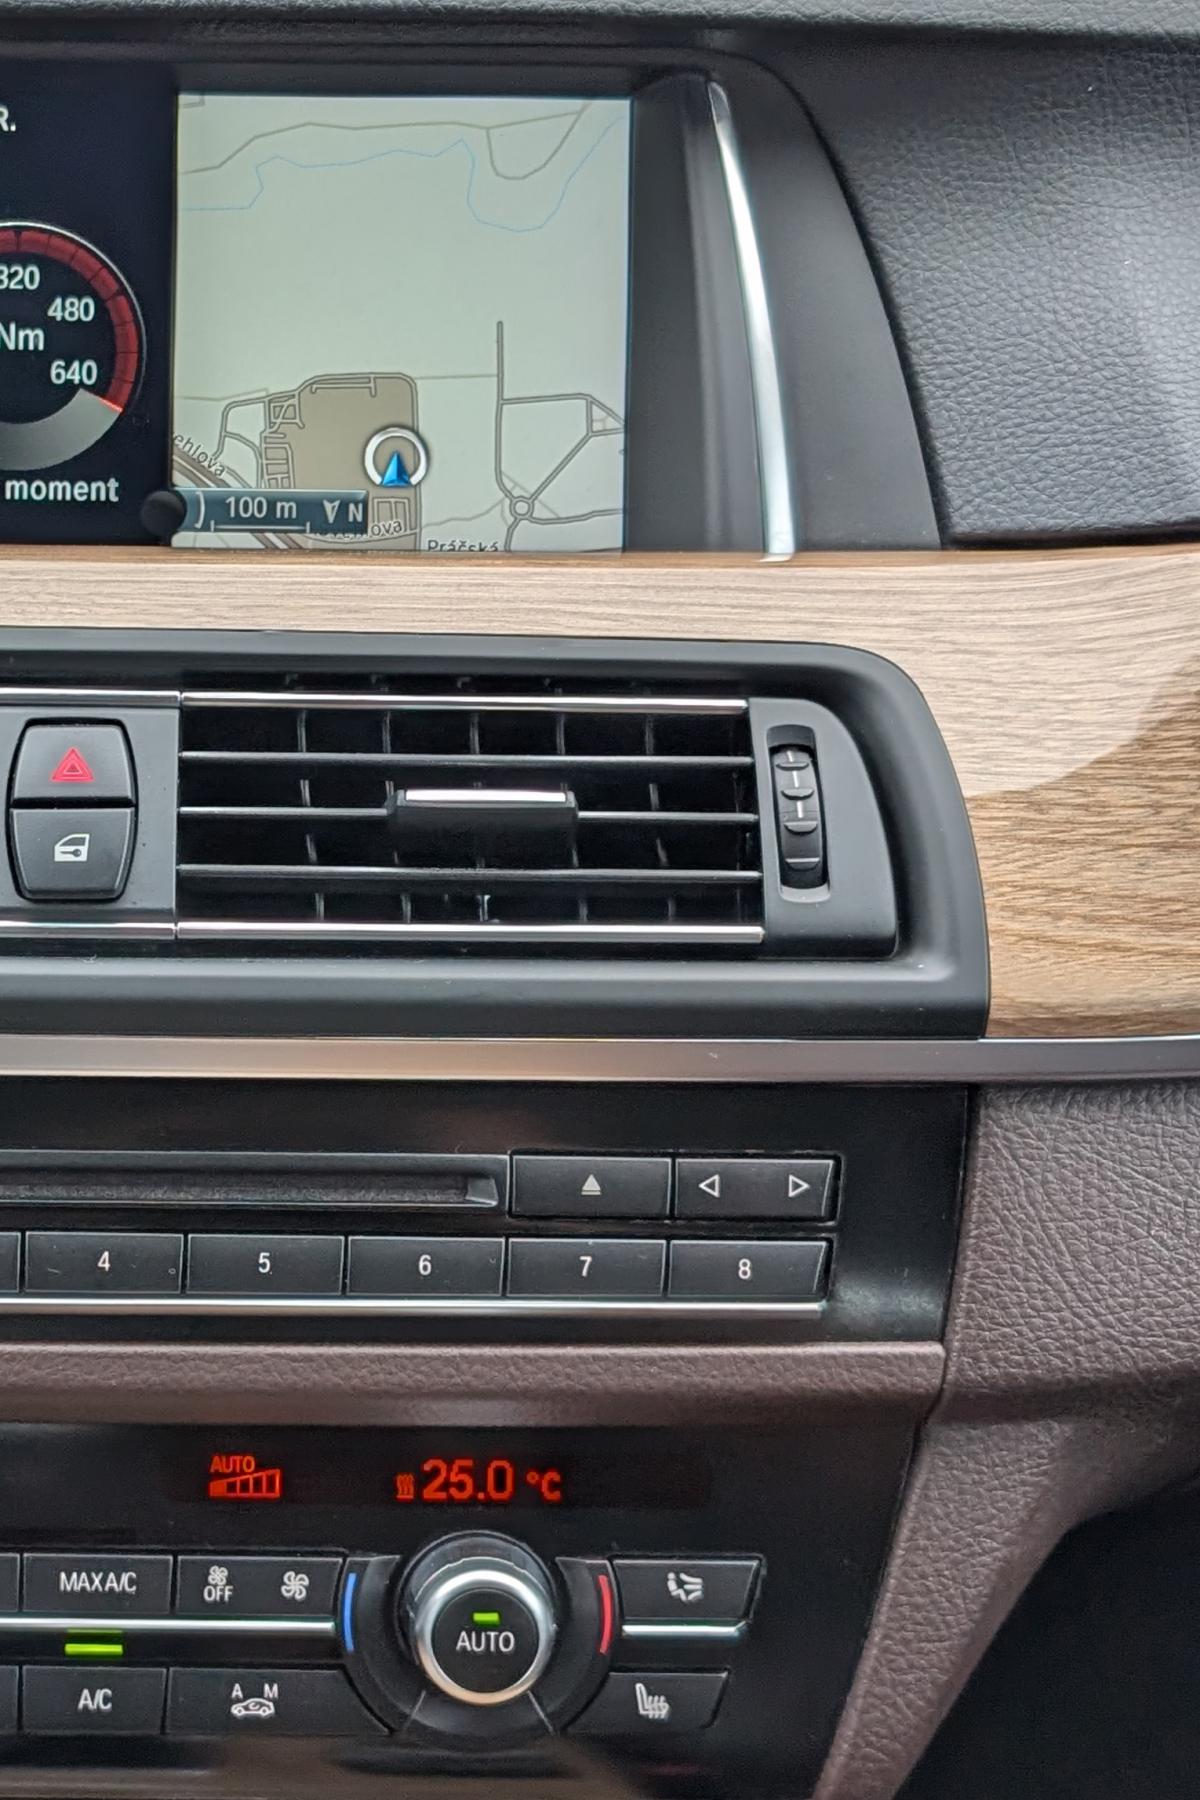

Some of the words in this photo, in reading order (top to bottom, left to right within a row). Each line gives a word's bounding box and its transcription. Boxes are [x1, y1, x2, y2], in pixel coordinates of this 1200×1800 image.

[47, 296, 95, 322] 480
[50, 359, 98, 385] 640
[5, 477, 119, 503] moment
[225, 496, 268, 518] 100
[275, 501, 297, 519] m
[348, 502, 363, 522] N
[97, 1250, 111, 1272] 4
[258, 1251, 271, 1274] 5
[418, 1254, 432, 1276] 6
[579, 1255, 593, 1277] 7
[738, 1258, 752, 1280] 8
[209, 1455, 256, 1474] AUTO
[422, 1458, 514, 1501] 25.0
[203, 1585, 234, 1602] OFF
[455, 1630, 515, 1653] AUTO
[77, 1688, 112, 1710] A/C
[231, 1683, 244, 1699] A
[263, 1683, 279, 1699] M
